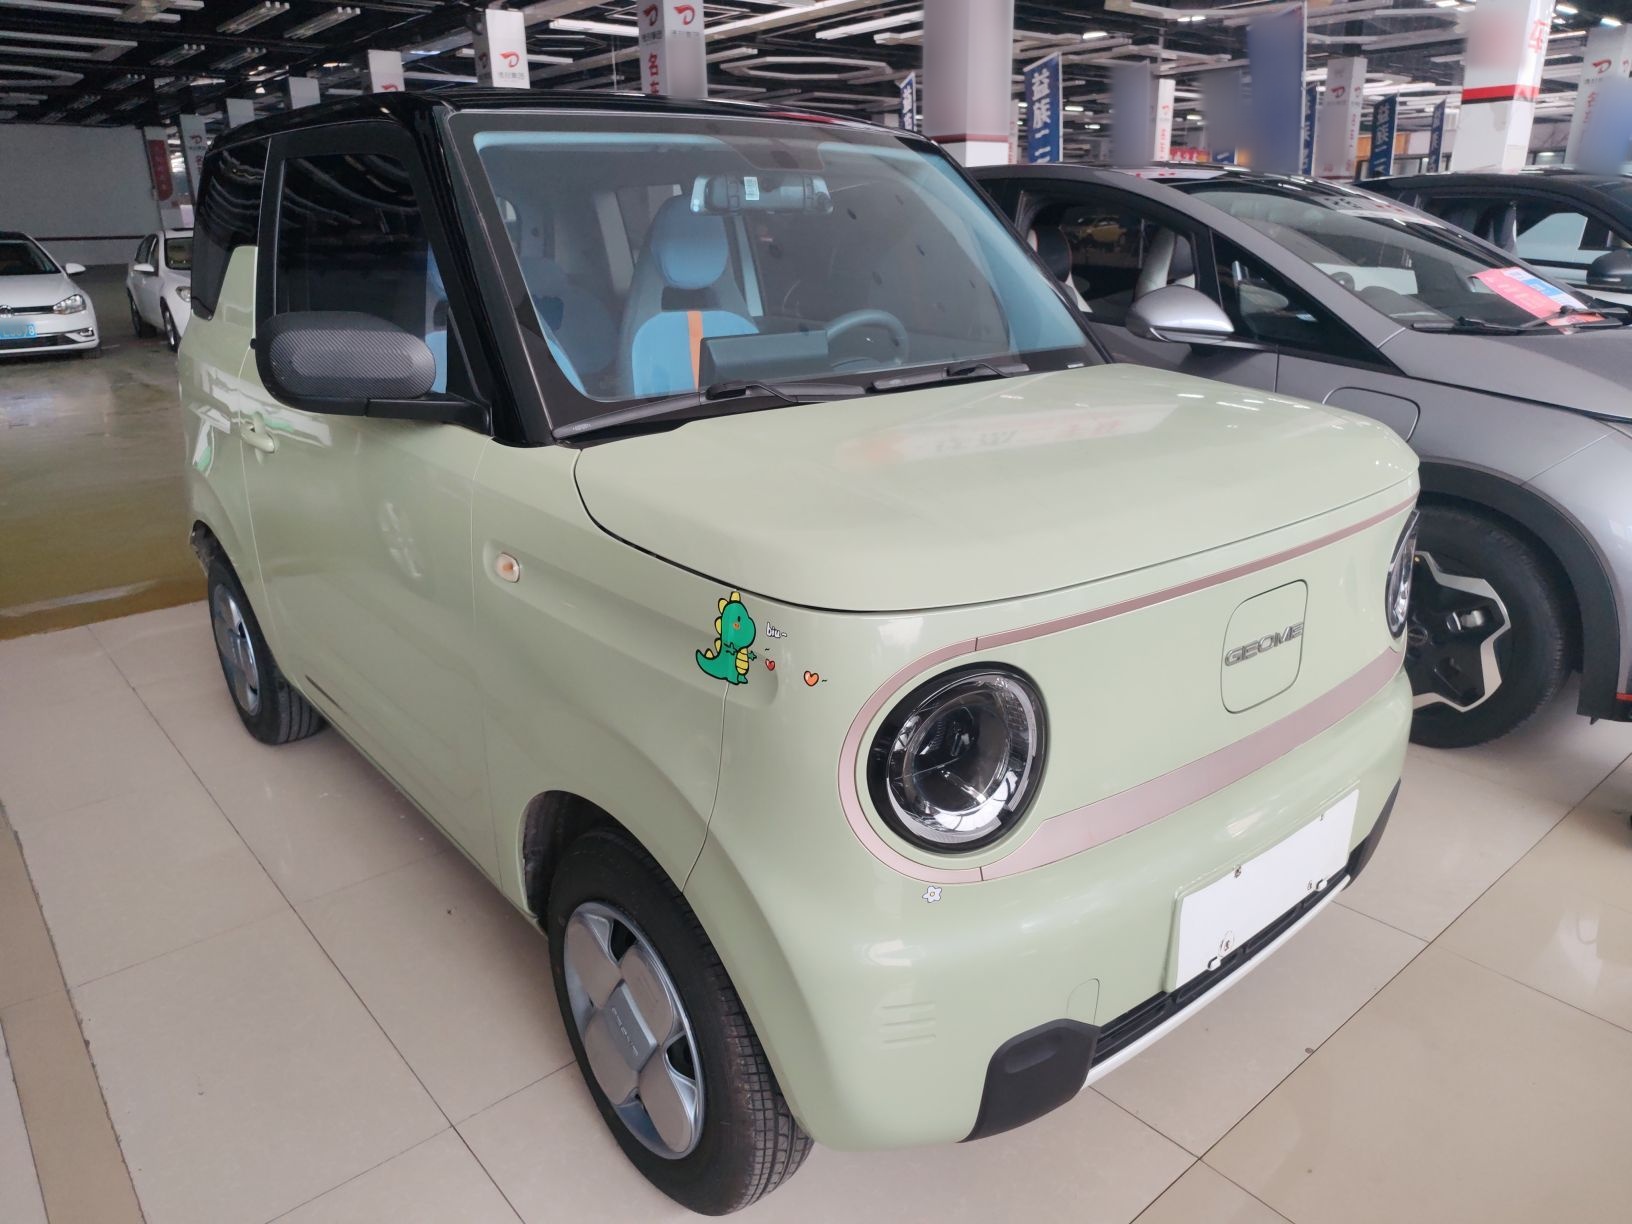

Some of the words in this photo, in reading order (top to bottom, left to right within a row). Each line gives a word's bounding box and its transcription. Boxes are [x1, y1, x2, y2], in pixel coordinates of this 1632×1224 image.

[1031, 68, 1052, 163] 益族二
[1224, 621, 1304, 667] GEOME
